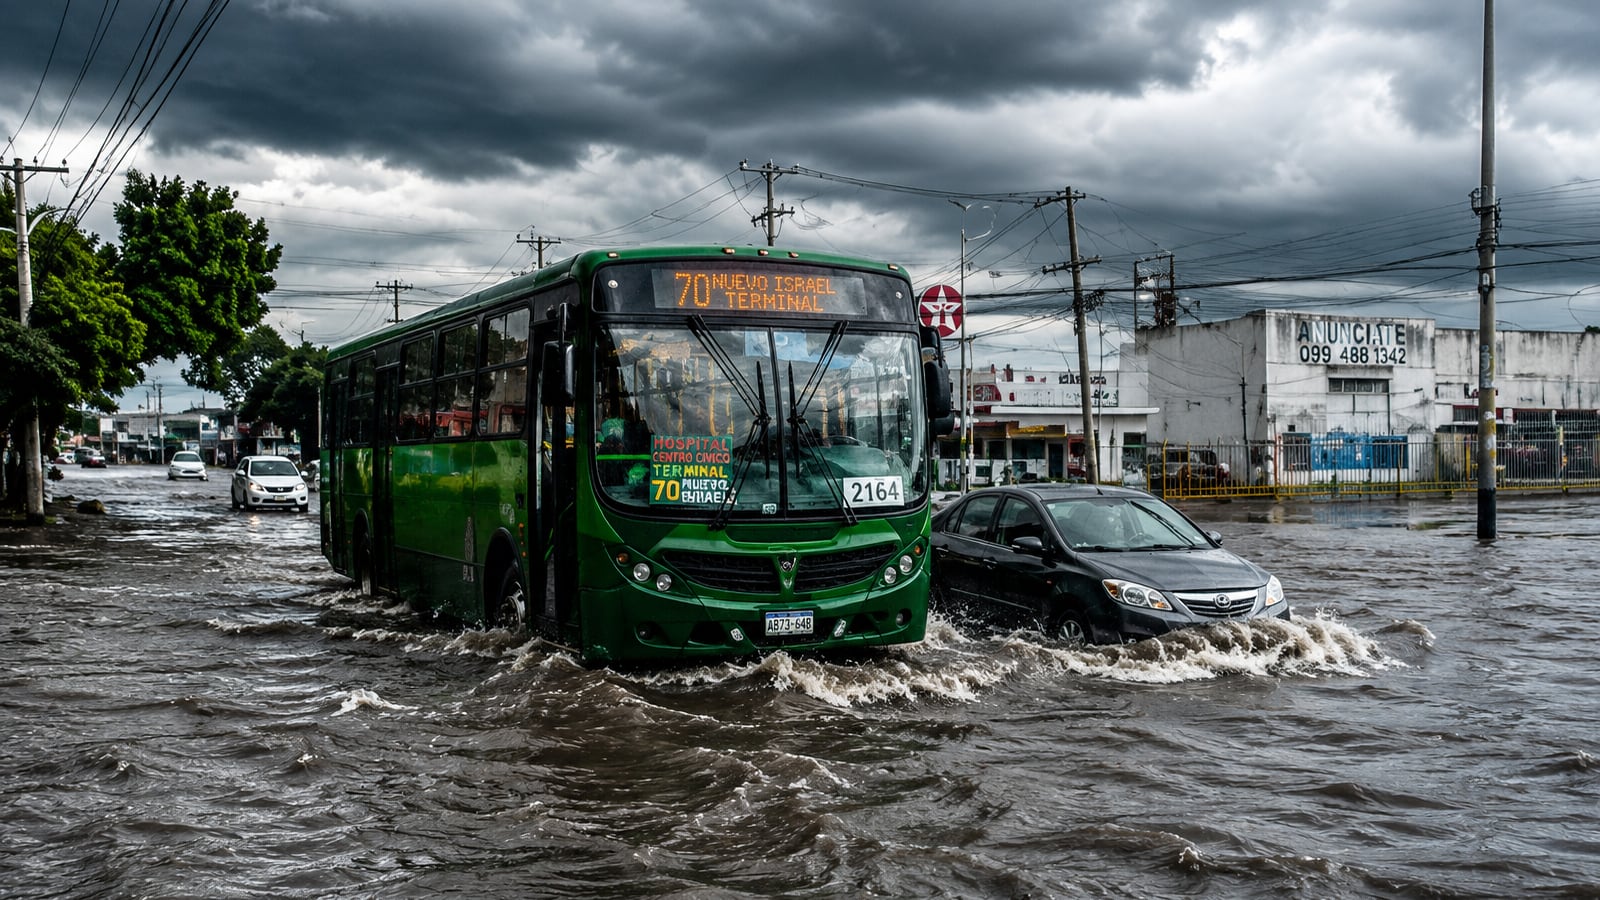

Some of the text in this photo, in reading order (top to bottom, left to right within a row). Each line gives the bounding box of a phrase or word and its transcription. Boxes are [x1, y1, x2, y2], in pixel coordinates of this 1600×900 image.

[675, 272, 710, 307] 70
[712, 273, 836, 295] NUEVO ISRAEL
[725, 291, 824, 312] TERMINAL
[1297, 320, 1406, 346] ANUNCIATE
[1300, 345, 1407, 365] 099 488 1342
[654, 436, 729, 451] HOSPITAL
[653, 451, 730, 464] CENTRO CIVICO
[653, 464, 728, 478] TERMINAL
[651, 479, 680, 501] 70
[851, 481, 900, 502] 2164
[768, 617, 812, 632] AB73-648
